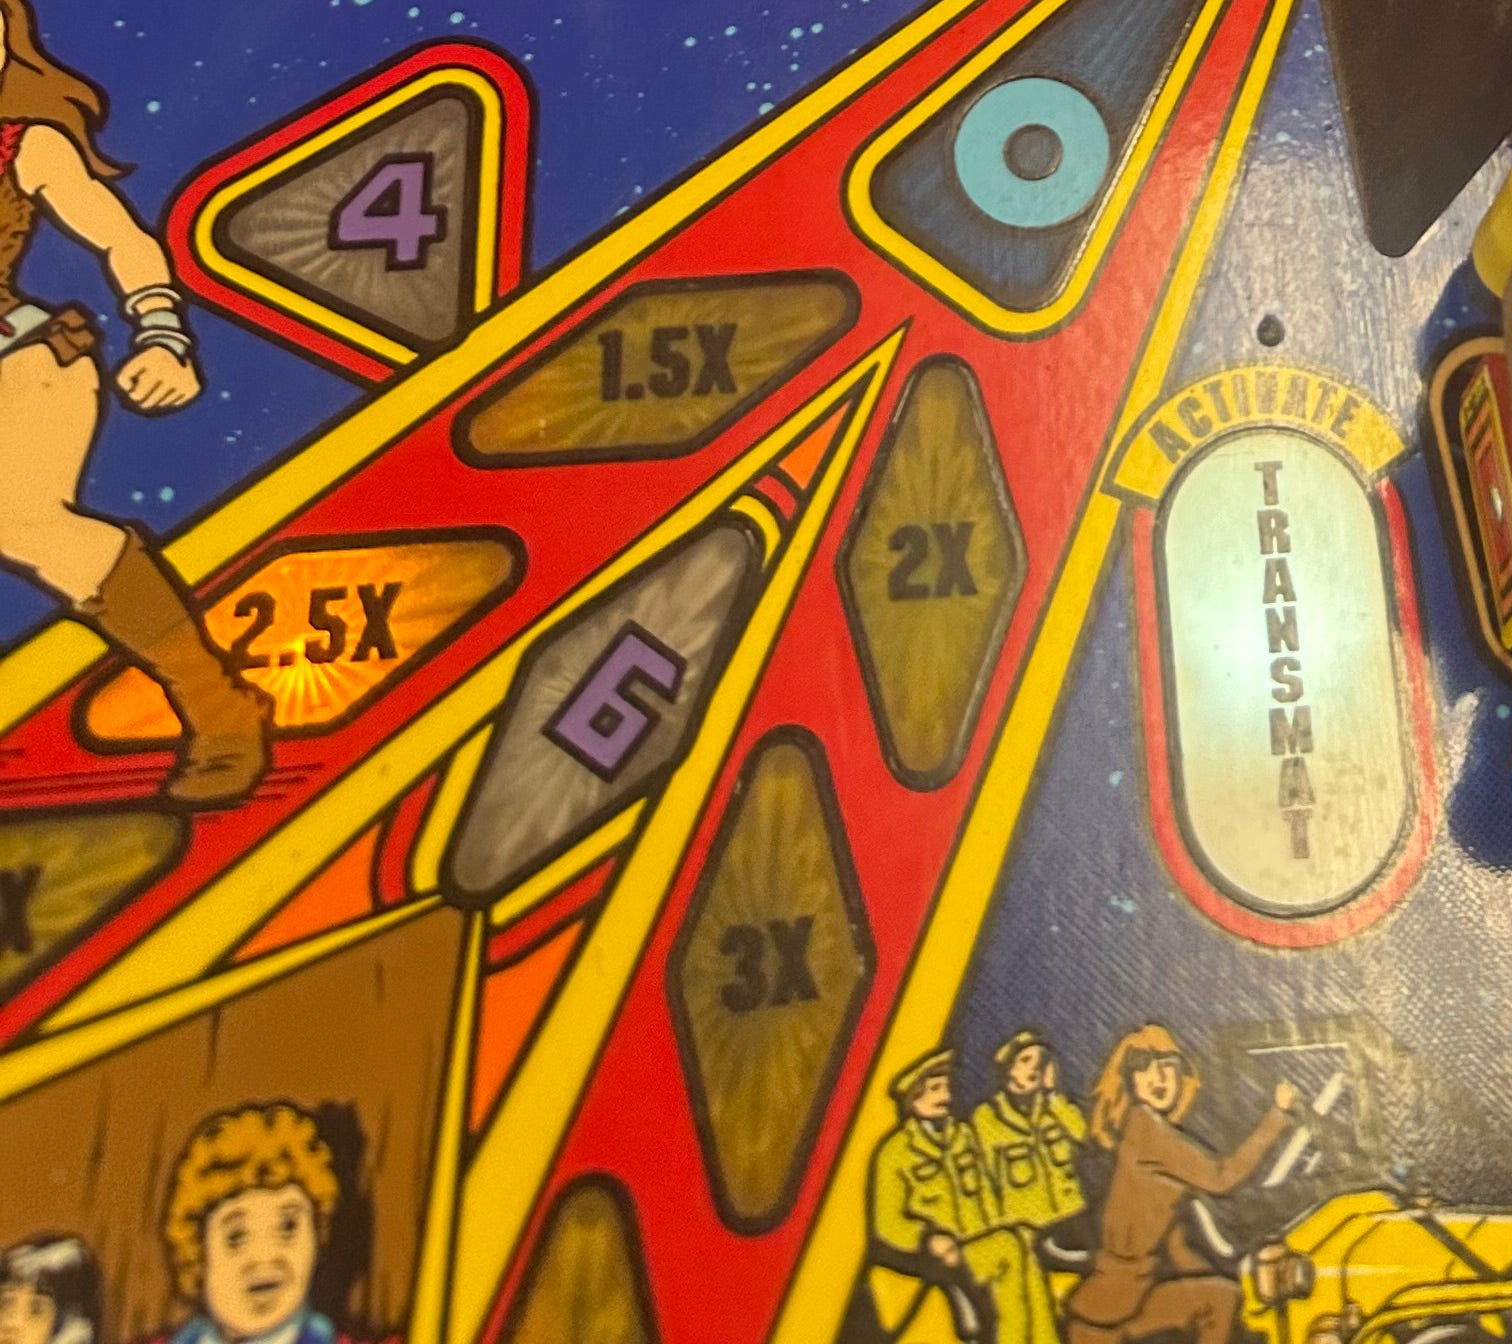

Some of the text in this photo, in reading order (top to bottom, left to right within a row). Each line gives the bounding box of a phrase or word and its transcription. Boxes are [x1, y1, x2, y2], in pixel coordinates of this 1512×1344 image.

[328, 152, 448, 271] 4
[598, 324, 739, 402] 1.5X
[886, 521, 977, 602] 2X
[230, 582, 402, 672] 2.5X
[1253, 461, 1316, 860] TRANSMAT
[541, 620, 687, 782] 6
[719, 917, 821, 1013] 3X
